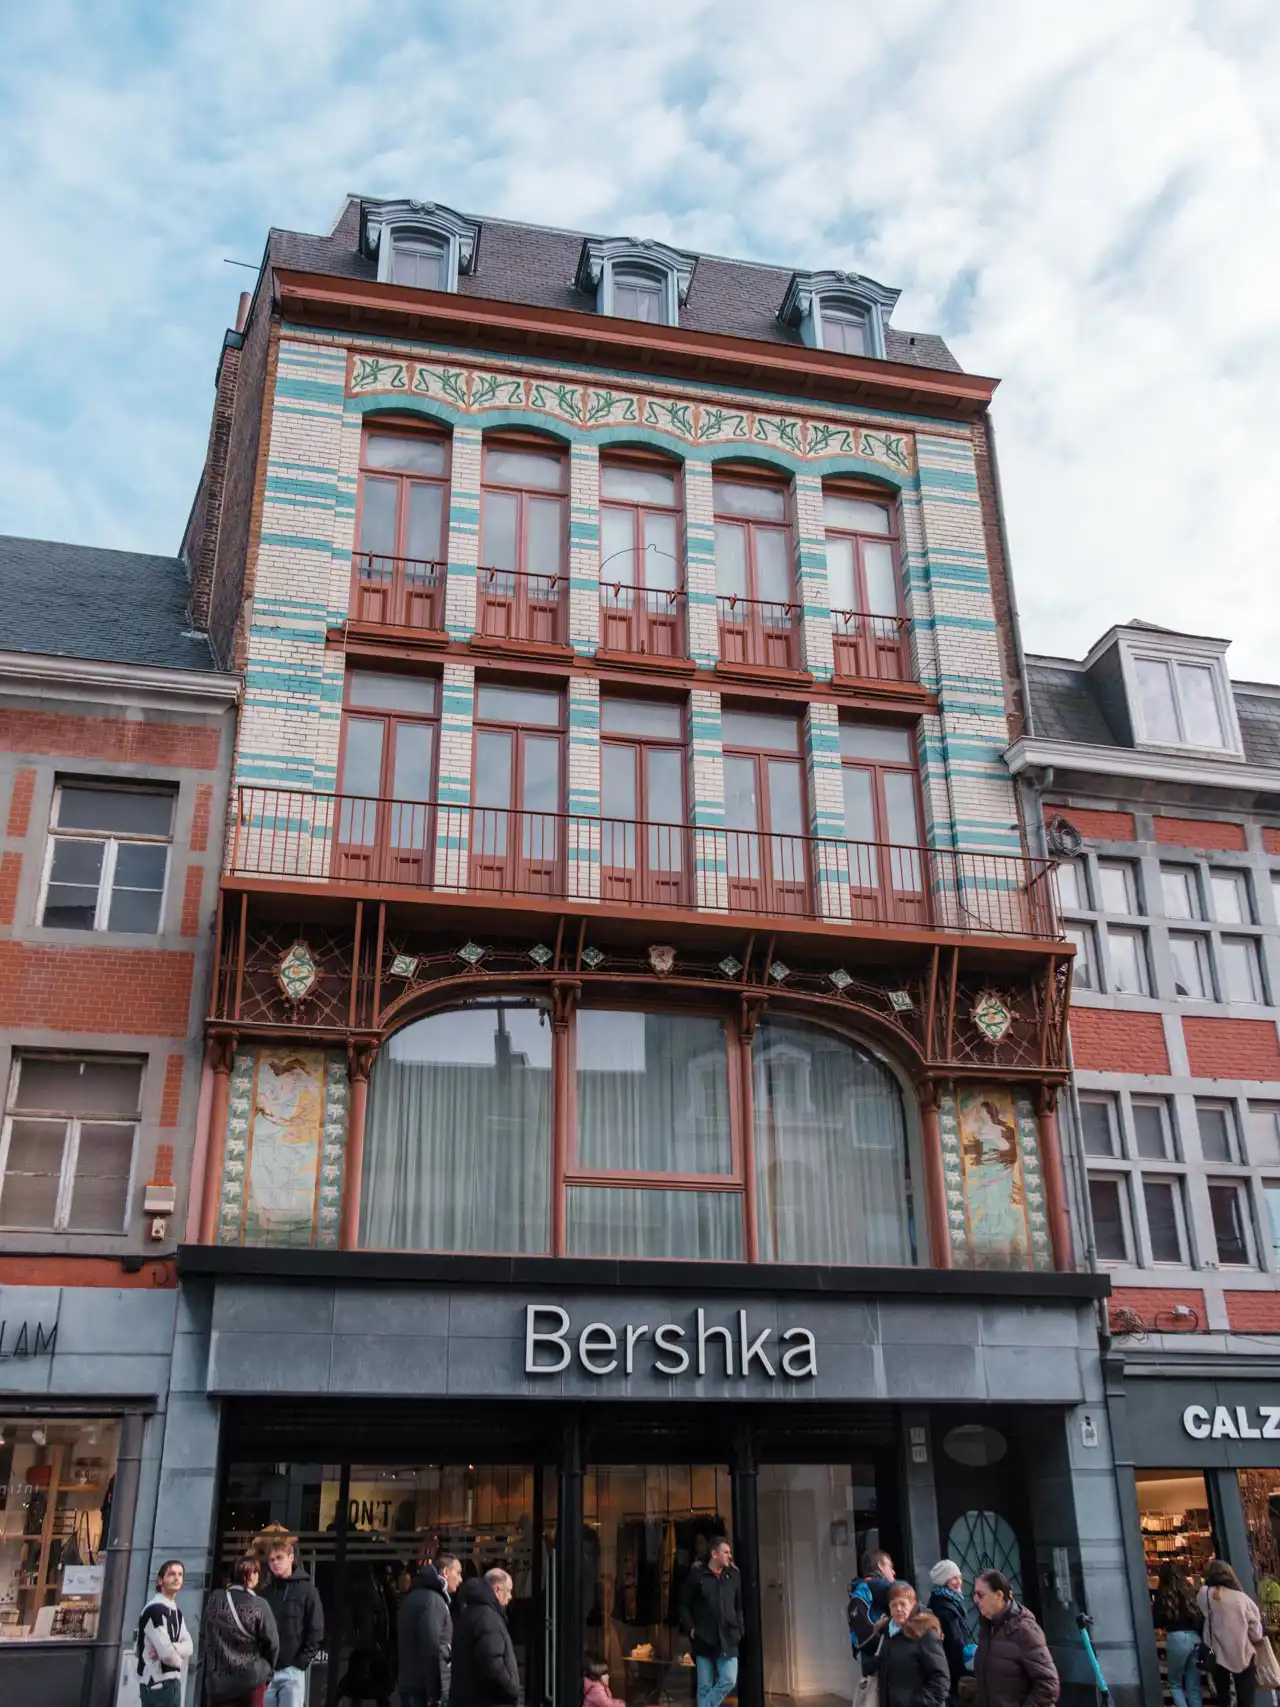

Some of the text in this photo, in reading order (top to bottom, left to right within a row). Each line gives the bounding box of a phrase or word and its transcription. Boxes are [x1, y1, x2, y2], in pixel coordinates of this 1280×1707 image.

[525, 1304, 818, 1377] Bershka
[1183, 1404, 1280, 1439] CALZ
[336, 1499, 392, 1527] ON'T
